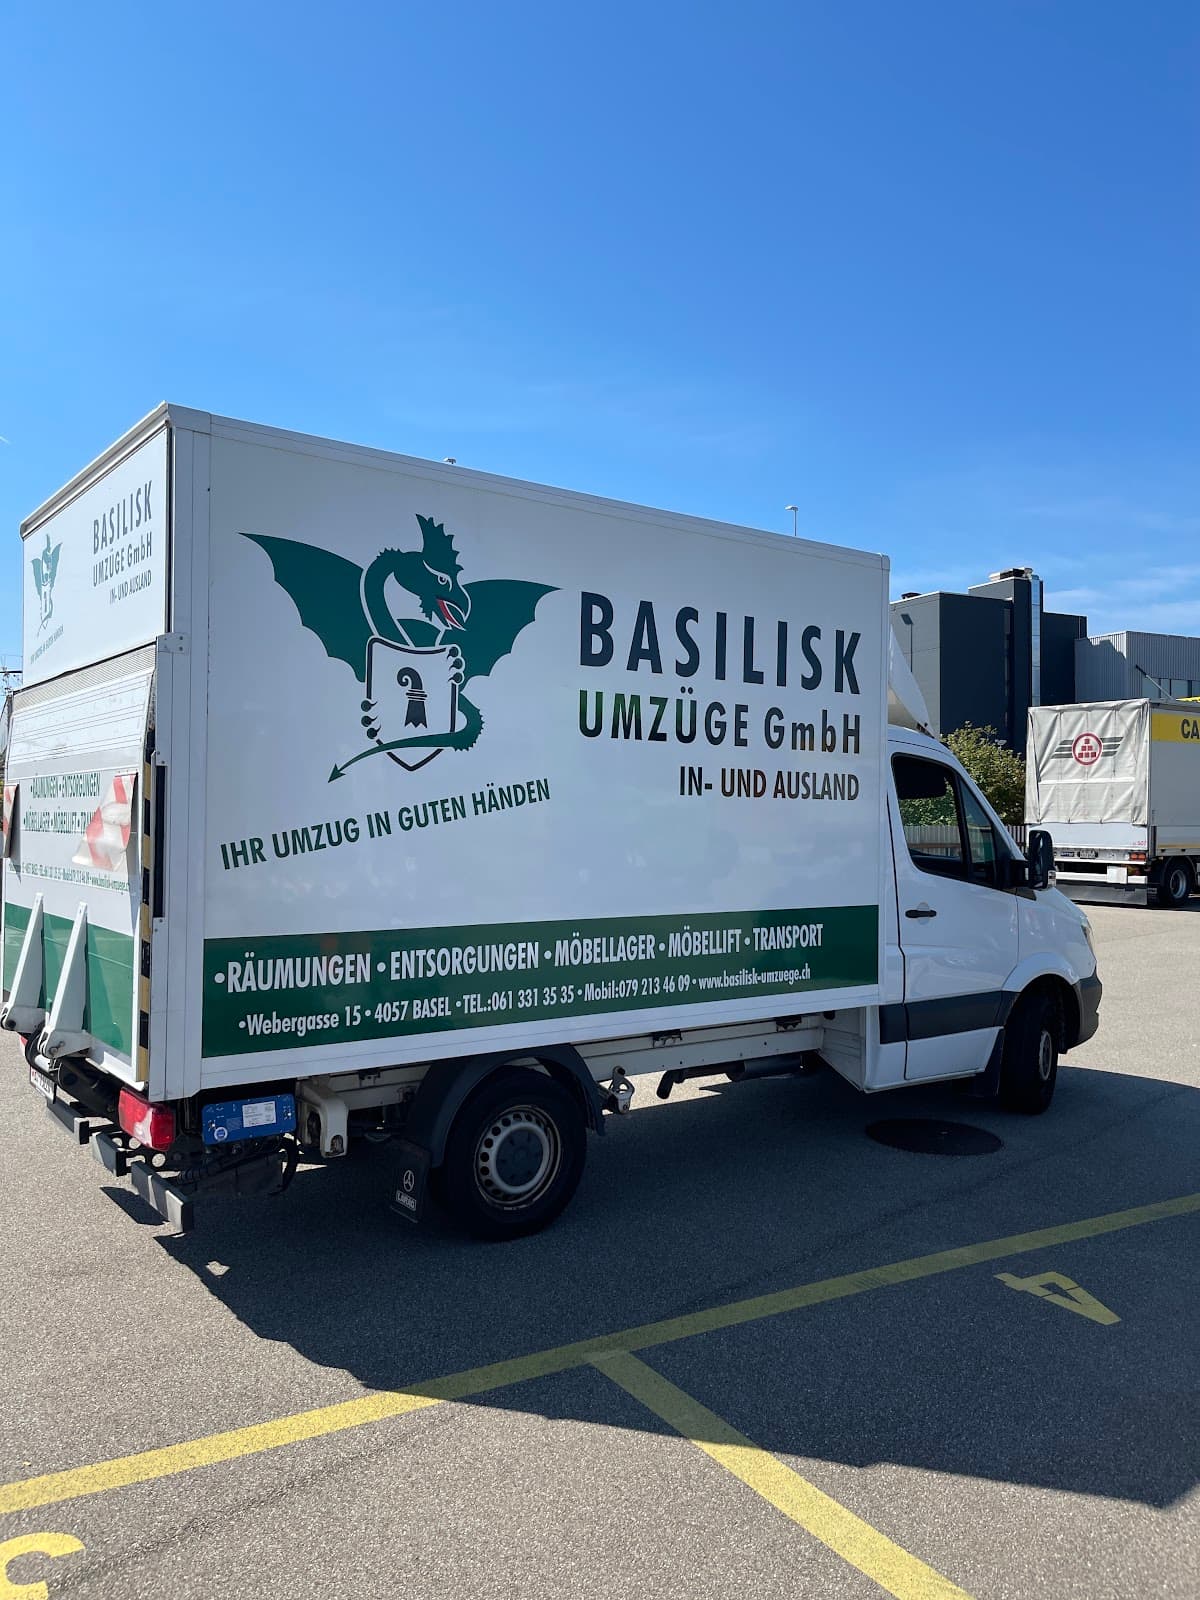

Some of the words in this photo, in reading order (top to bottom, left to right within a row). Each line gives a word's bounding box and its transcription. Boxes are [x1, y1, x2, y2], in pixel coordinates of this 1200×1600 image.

[93, 480, 152, 555] BASILISK
[93, 547, 125, 587] UMZÜGE
[127, 531, 152, 567] GmbH
[579, 591, 861, 694] BASILISK
[579, 686, 748, 747] UMZÜGE
[764, 707, 860, 754] GmbH
[680, 766, 713, 796] IN-
[721, 768, 767, 798] UND
[773, 771, 859, 801] AUSLAND
[220, 837, 267, 870] IHR
[272, 817, 360, 859] UMZUG
[366, 811, 392, 838] IN
[398, 795, 467, 831] GUTEN
[472, 778, 551, 816] HÄNDEN
[227, 951, 371, 993] RÄUMUNGEN
[390, 942, 539, 981] ENTSORGUNGEN
[554, 932, 655, 967] MÖBELLAGER
[668, 925, 742, 958] MÖBELLIFT
[753, 923, 824, 951] TRANSPORT
[246, 1010, 339, 1037] Webergasse
[344, 1006, 361, 1027] 15
[374, 1001, 409, 1024] 4057
[412, 996, 451, 1020] BASEL
[518, 987, 540, 1009] 331
[543, 987, 557, 1006] 35
[560, 985, 574, 1004] 35
[642, 978, 660, 996] 213
[663, 975, 676, 994] 46
[678, 974, 691, 992] 09
[699, 962, 811, 991] www.basilisk-umzuege.ch
